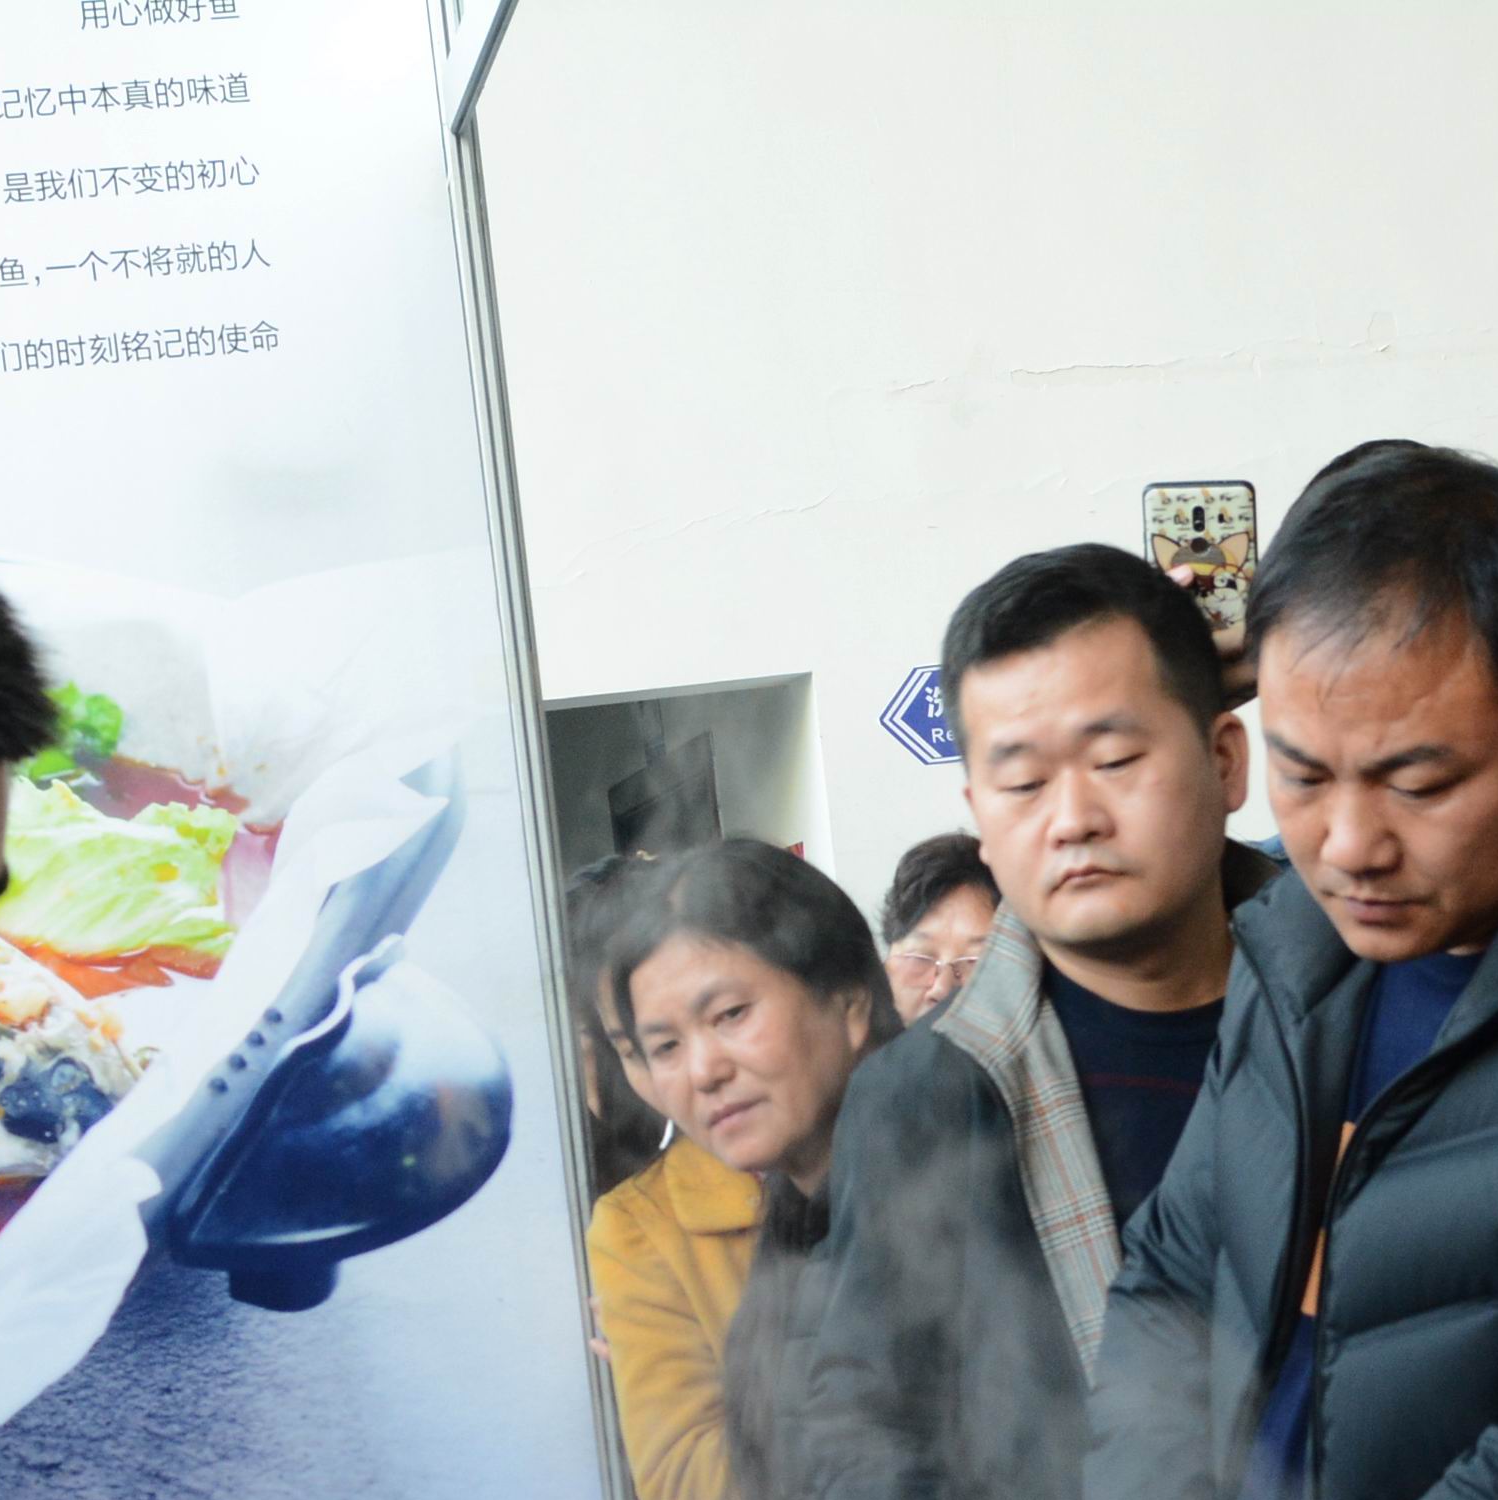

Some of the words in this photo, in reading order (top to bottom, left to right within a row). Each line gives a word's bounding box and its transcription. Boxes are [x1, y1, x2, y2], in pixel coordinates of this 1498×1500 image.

[80, 0, 241, 31] 用心做好鱼
[2, 155, 260, 205] 是我们不变的初心
